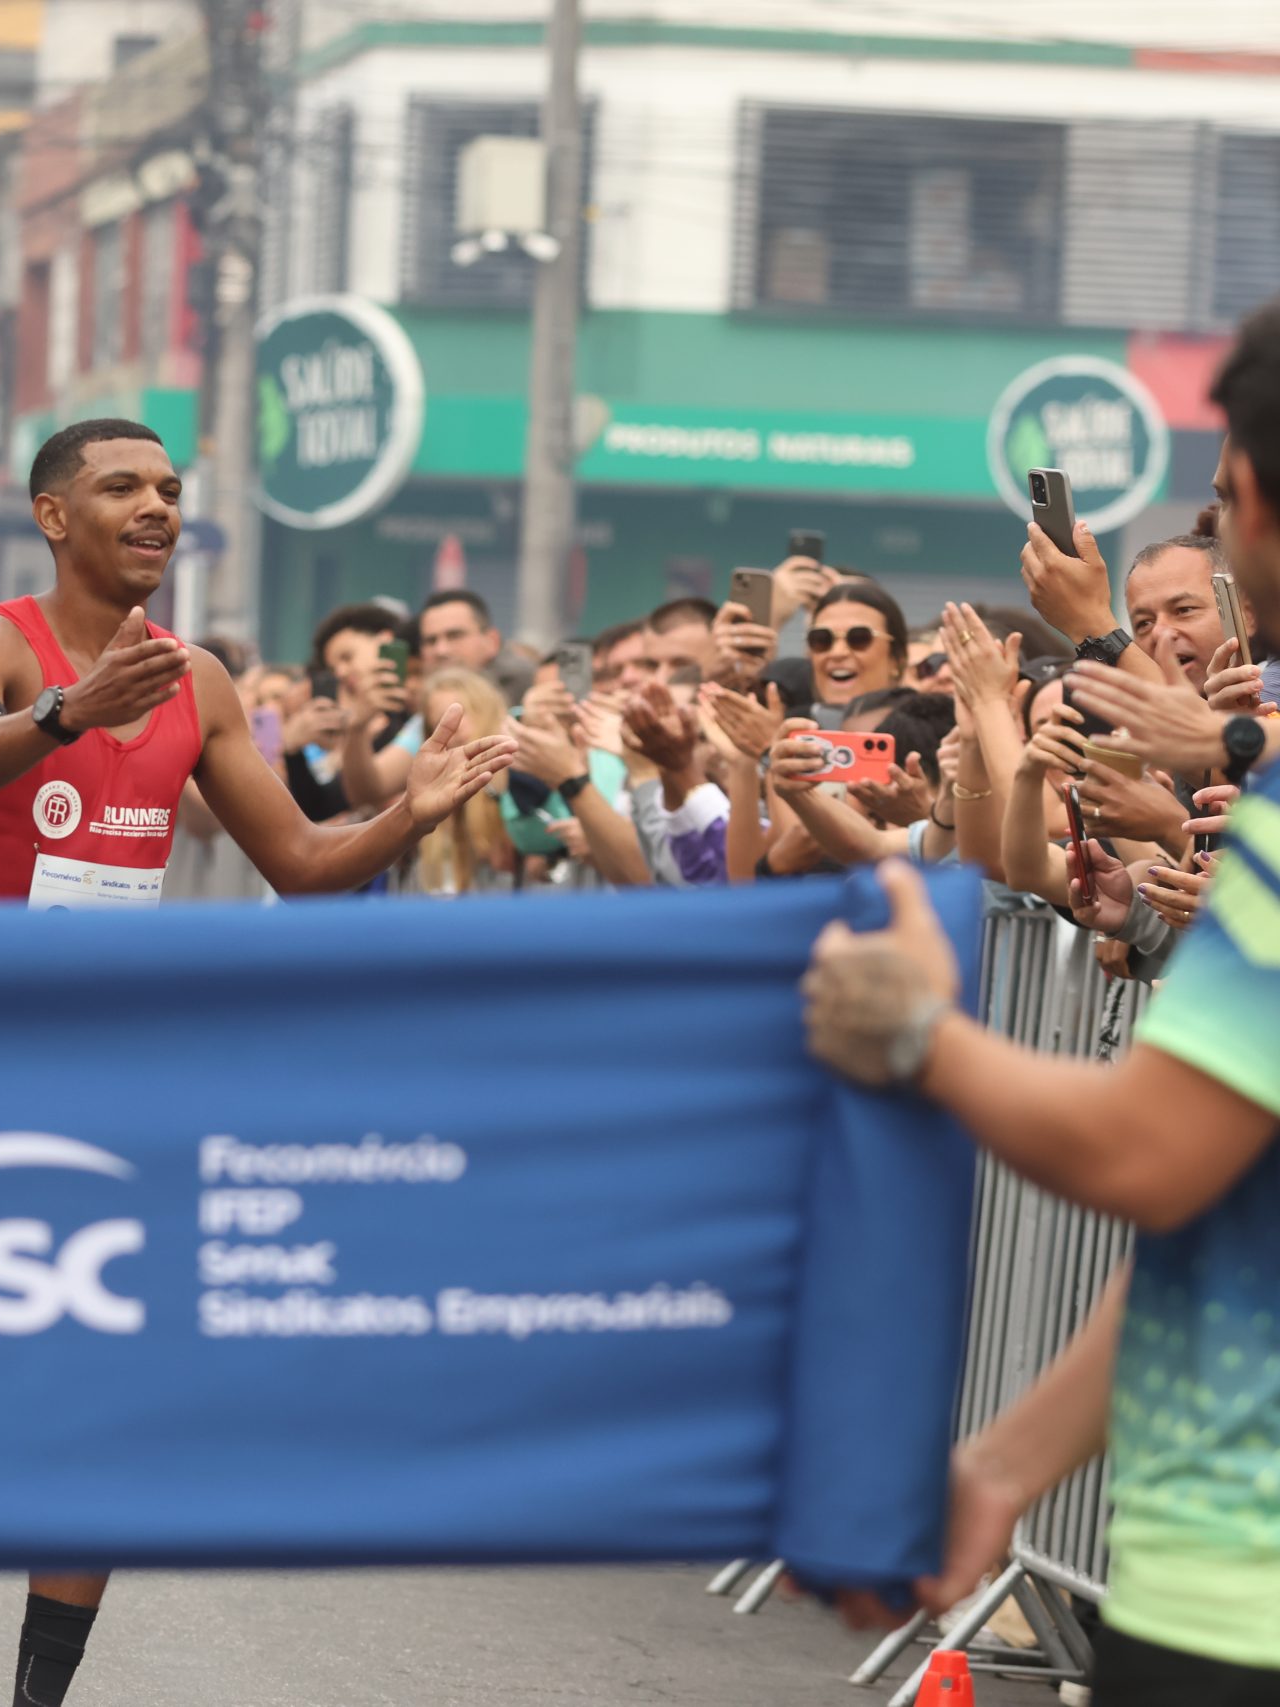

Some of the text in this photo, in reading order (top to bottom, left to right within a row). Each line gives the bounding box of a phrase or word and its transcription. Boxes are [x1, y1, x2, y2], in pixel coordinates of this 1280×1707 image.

[605, 423, 915, 468] PRODUTOS NATURAIS
[104, 805, 171, 826] RUNNERS
[41, 869, 81, 883] Fecomércio
[101, 879, 131, 889] Sindicatos
[200, 1135, 464, 1183] Fecomércio
[200, 1190, 302, 1236] IFEP
[200, 1241, 335, 1285] Senac
[200, 1283, 731, 1341] Sindicatos Empresariais
